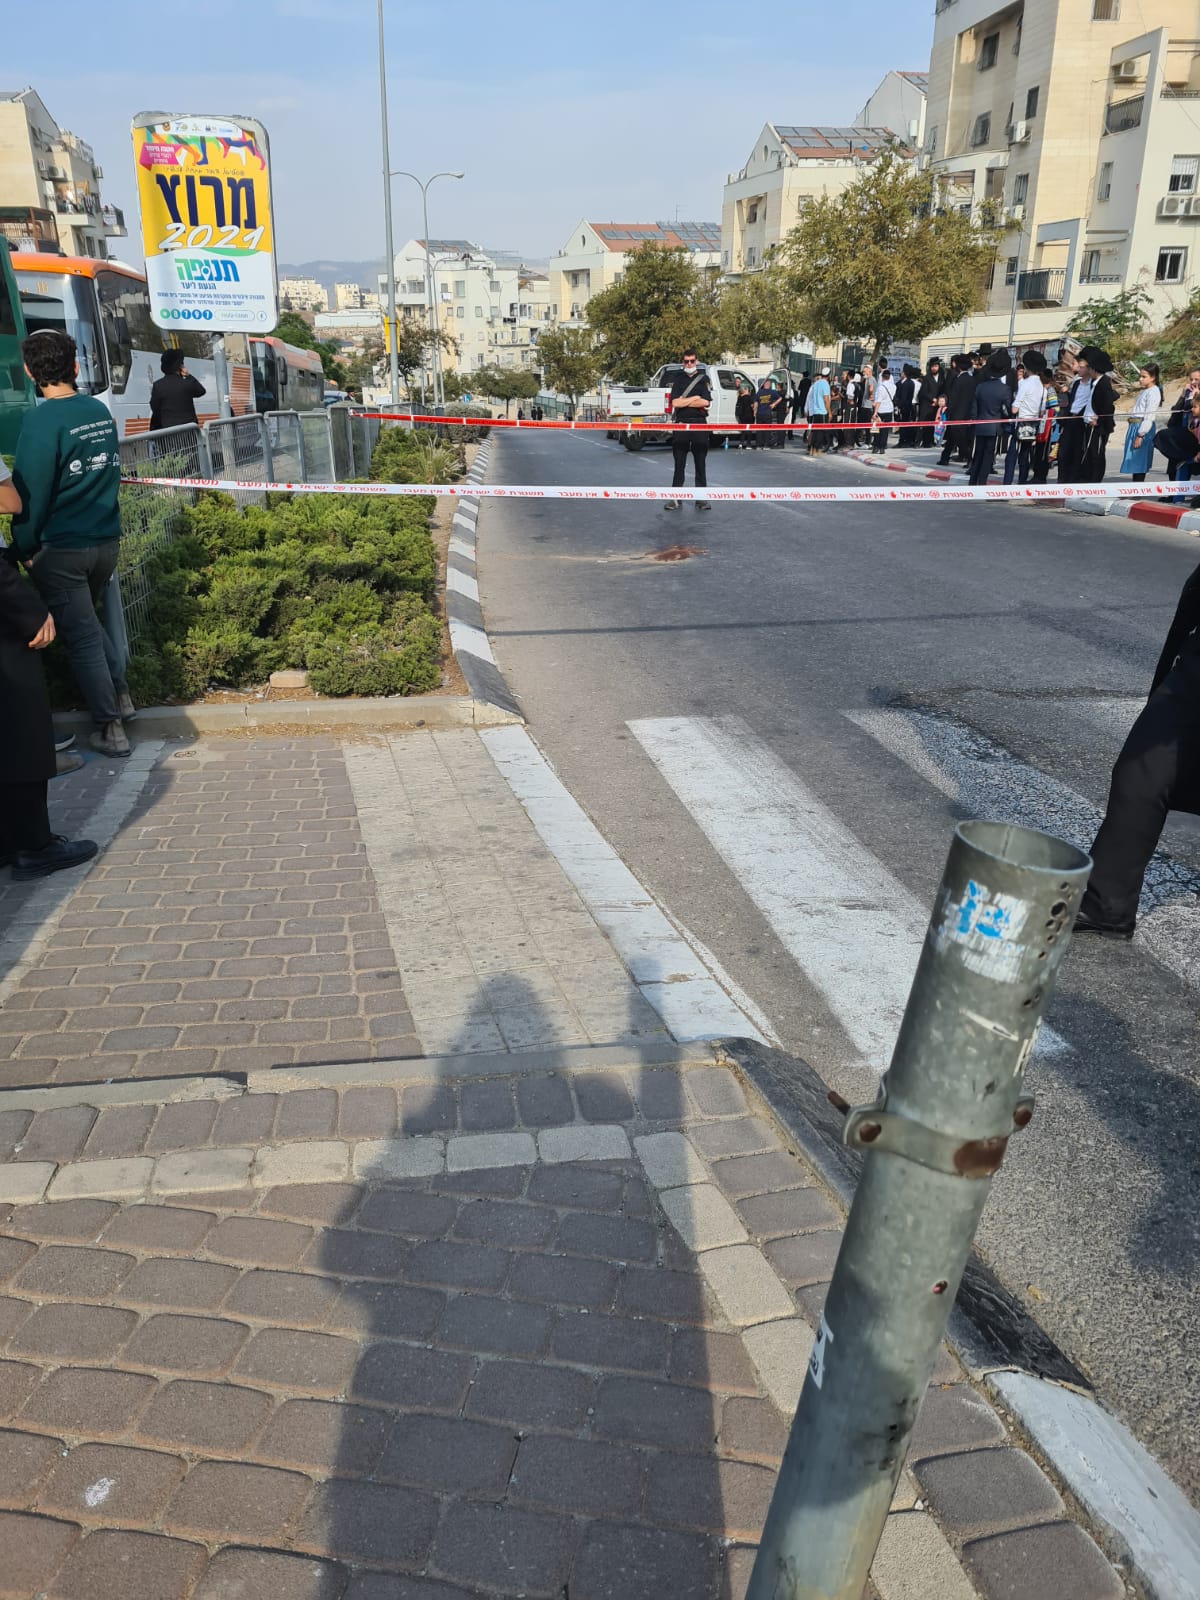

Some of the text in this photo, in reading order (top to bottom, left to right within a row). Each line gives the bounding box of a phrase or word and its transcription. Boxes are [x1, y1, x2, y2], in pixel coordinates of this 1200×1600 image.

[155, 173, 257, 234] מרוץ
[158, 222, 265, 250] 2021
[174, 258, 240, 282] תנופה
[943, 491, 974, 499] משטרת
[1165, 485, 1190, 493] ישראל
